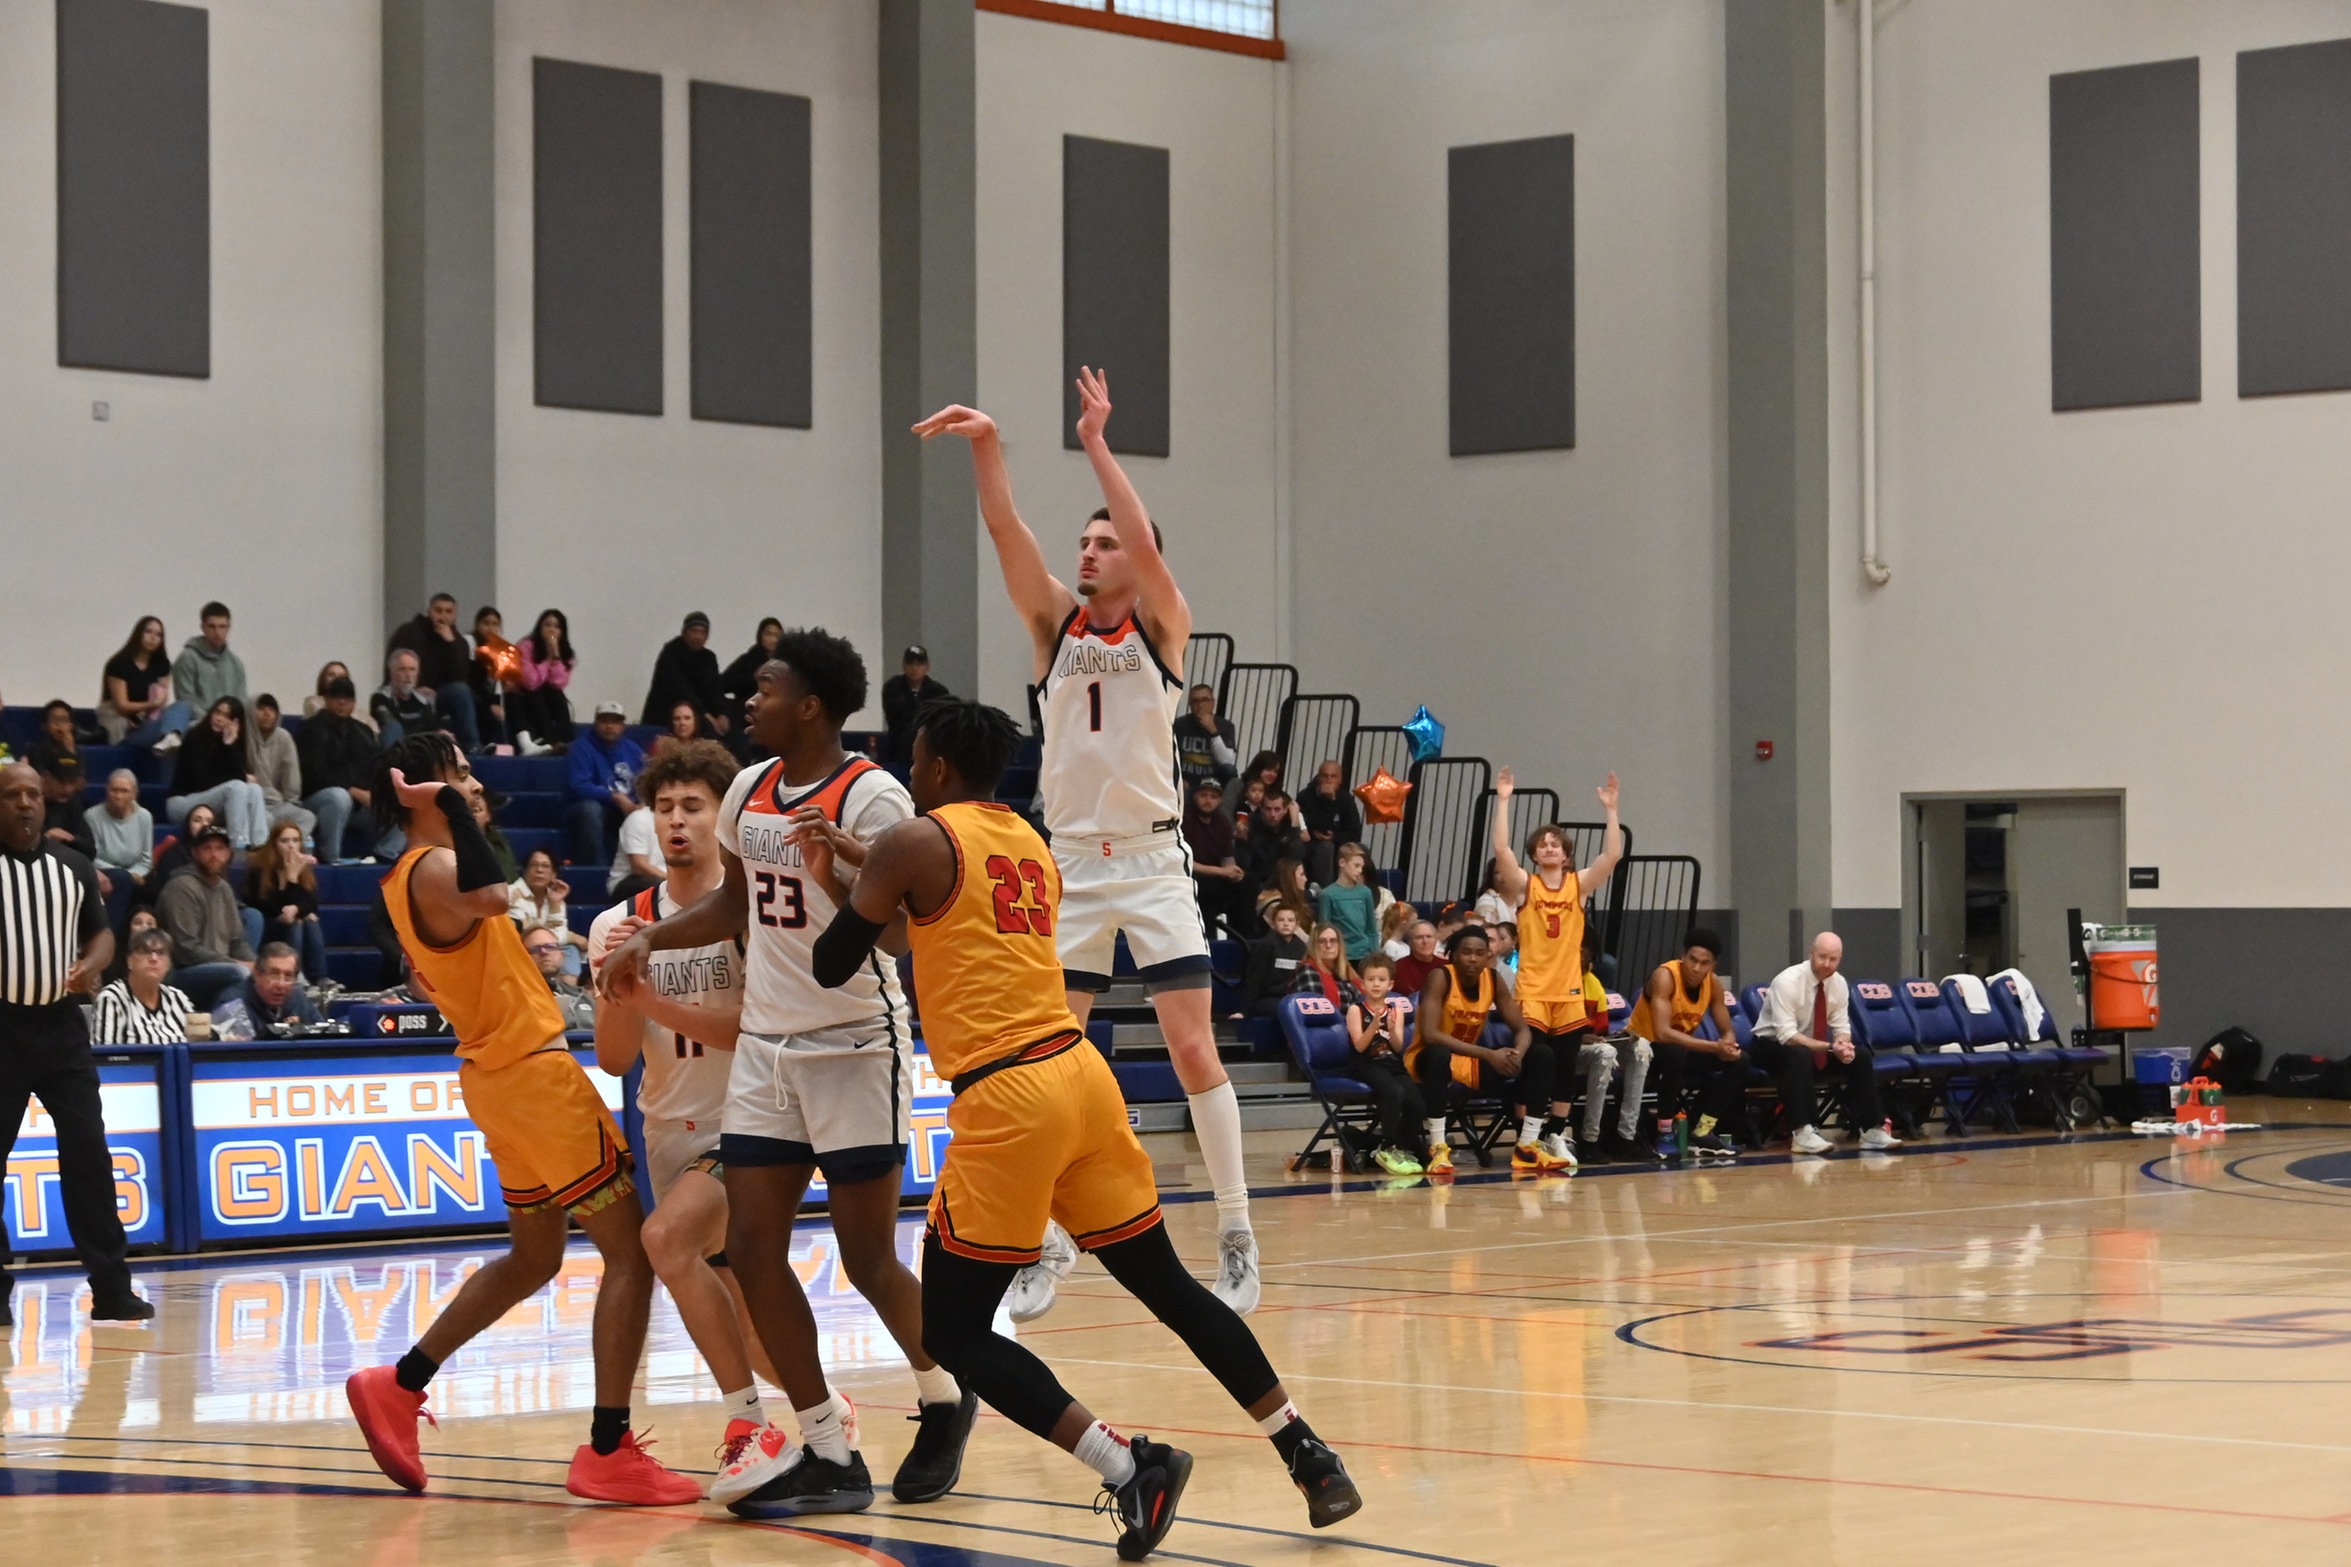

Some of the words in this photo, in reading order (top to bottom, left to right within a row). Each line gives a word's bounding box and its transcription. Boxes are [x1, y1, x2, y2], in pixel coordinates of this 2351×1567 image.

[1058, 644, 1141, 679] IANTS
[1087, 681, 1102, 732] 1
[1102, 842, 1111, 857] S
[755, 870, 807, 929] 23
[985, 854, 1052, 937] 23
[1546, 914, 1560, 938] 3
[648, 955, 731, 997] IANTS
[1857, 983, 1893, 999] COS
[1905, 982, 1941, 997] COS
[1296, 997, 1335, 1014] COS
[249, 1082, 388, 1119] HOME
[209, 1130, 492, 1226] GIAN
